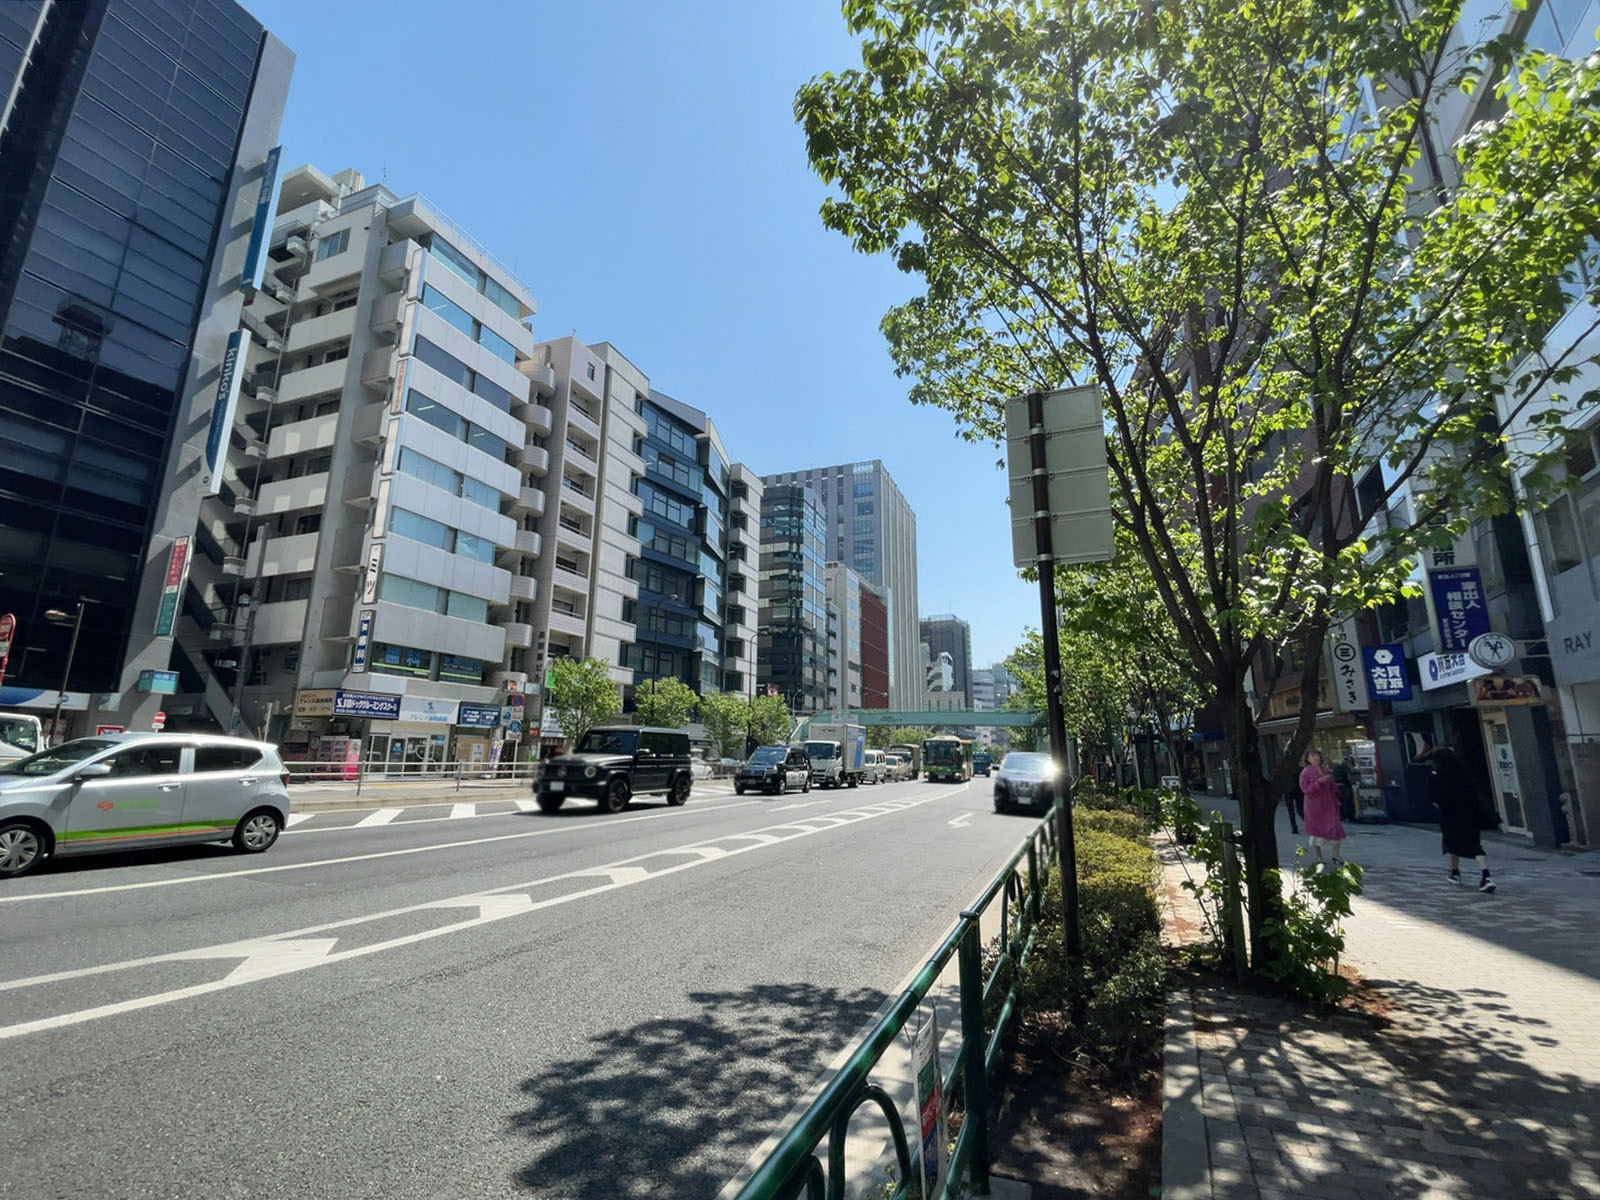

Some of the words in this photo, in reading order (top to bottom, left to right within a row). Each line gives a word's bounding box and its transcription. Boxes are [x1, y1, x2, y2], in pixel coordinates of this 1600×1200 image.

[1461, 581, 1481, 610] 家出人
[1564, 630, 1592, 655] RAY
[1340, 665, 1357, 704] みさき
